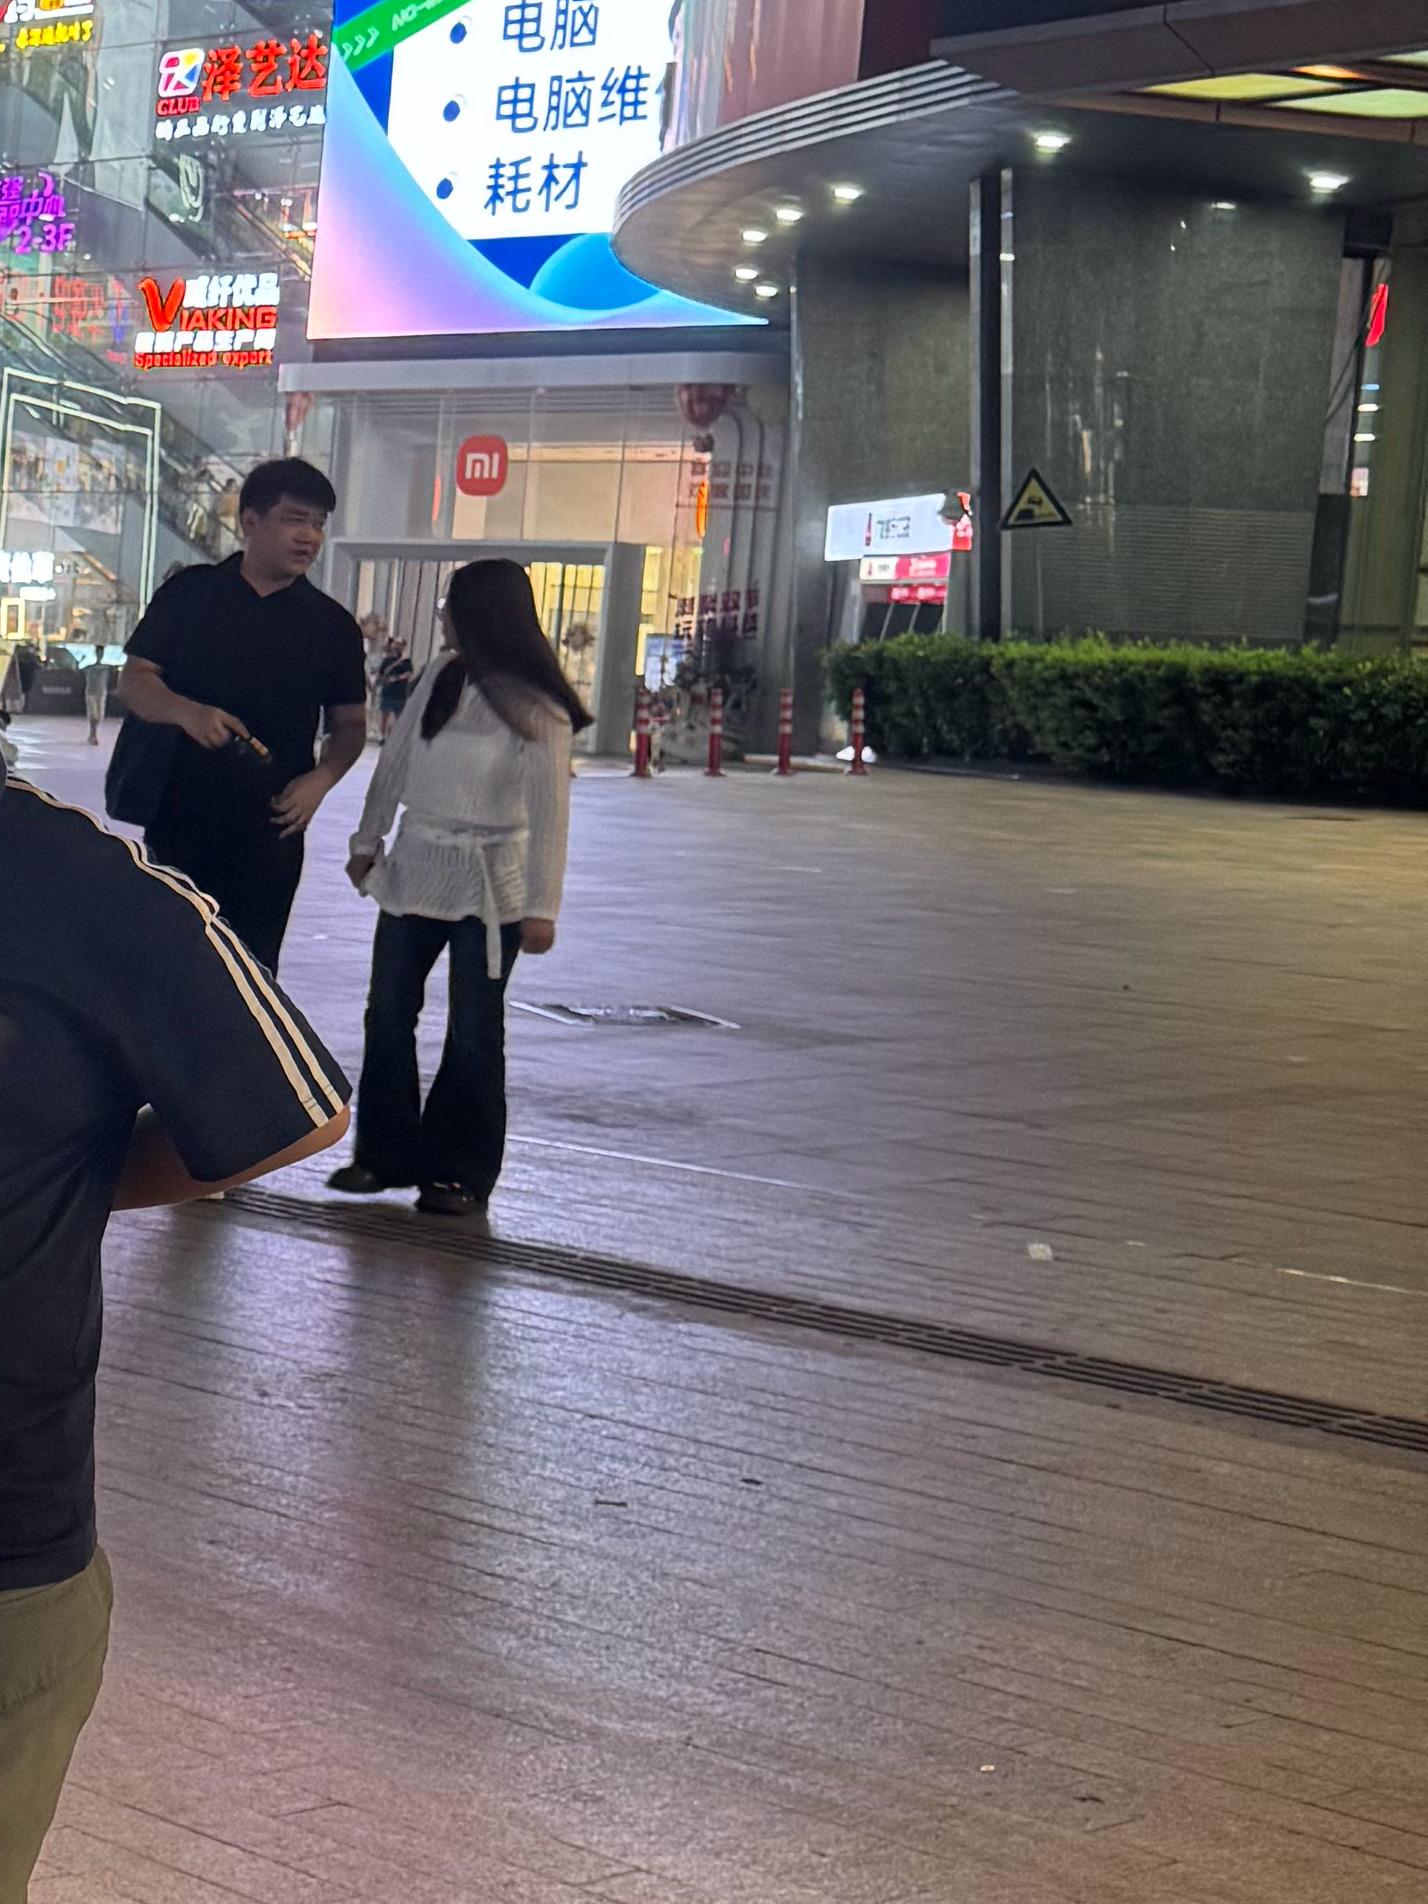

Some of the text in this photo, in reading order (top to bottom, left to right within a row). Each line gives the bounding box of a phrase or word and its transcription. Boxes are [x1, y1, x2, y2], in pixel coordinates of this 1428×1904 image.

[202, 34, 329, 102] 泽艺达
[495, 65, 666, 134] 电脑维
[483, 152, 589, 216] 耗材
